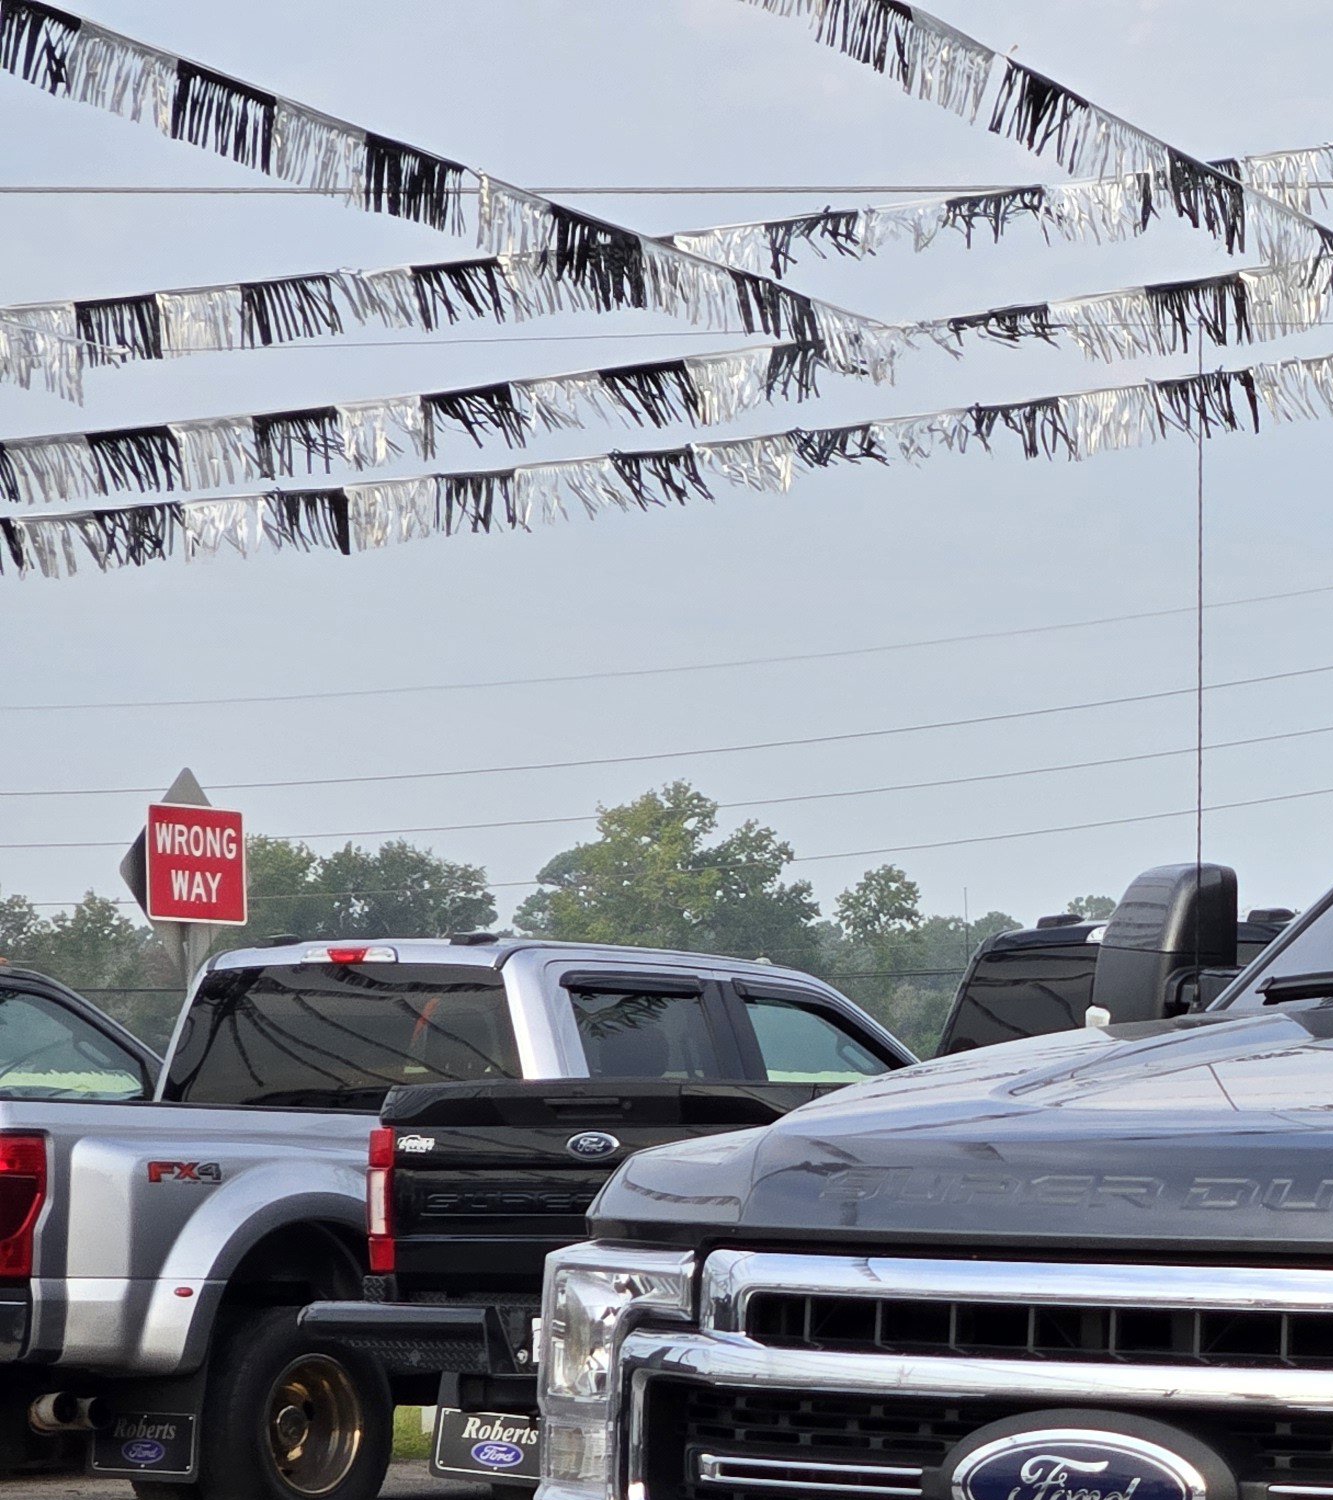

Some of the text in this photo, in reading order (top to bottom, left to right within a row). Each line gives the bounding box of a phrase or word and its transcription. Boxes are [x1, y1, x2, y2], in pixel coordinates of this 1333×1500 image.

[155, 822, 237, 860] WRONG
[171, 869, 222, 903] WAY
[147, 1160, 222, 1184] FX4
[819, 1170, 1165, 1208] SUPER
[114, 1417, 177, 1440] Roberts
[461, 1416, 539, 1445] Roberts
[129, 1443, 159, 1458] Ford
[480, 1445, 516, 1462] Ford
